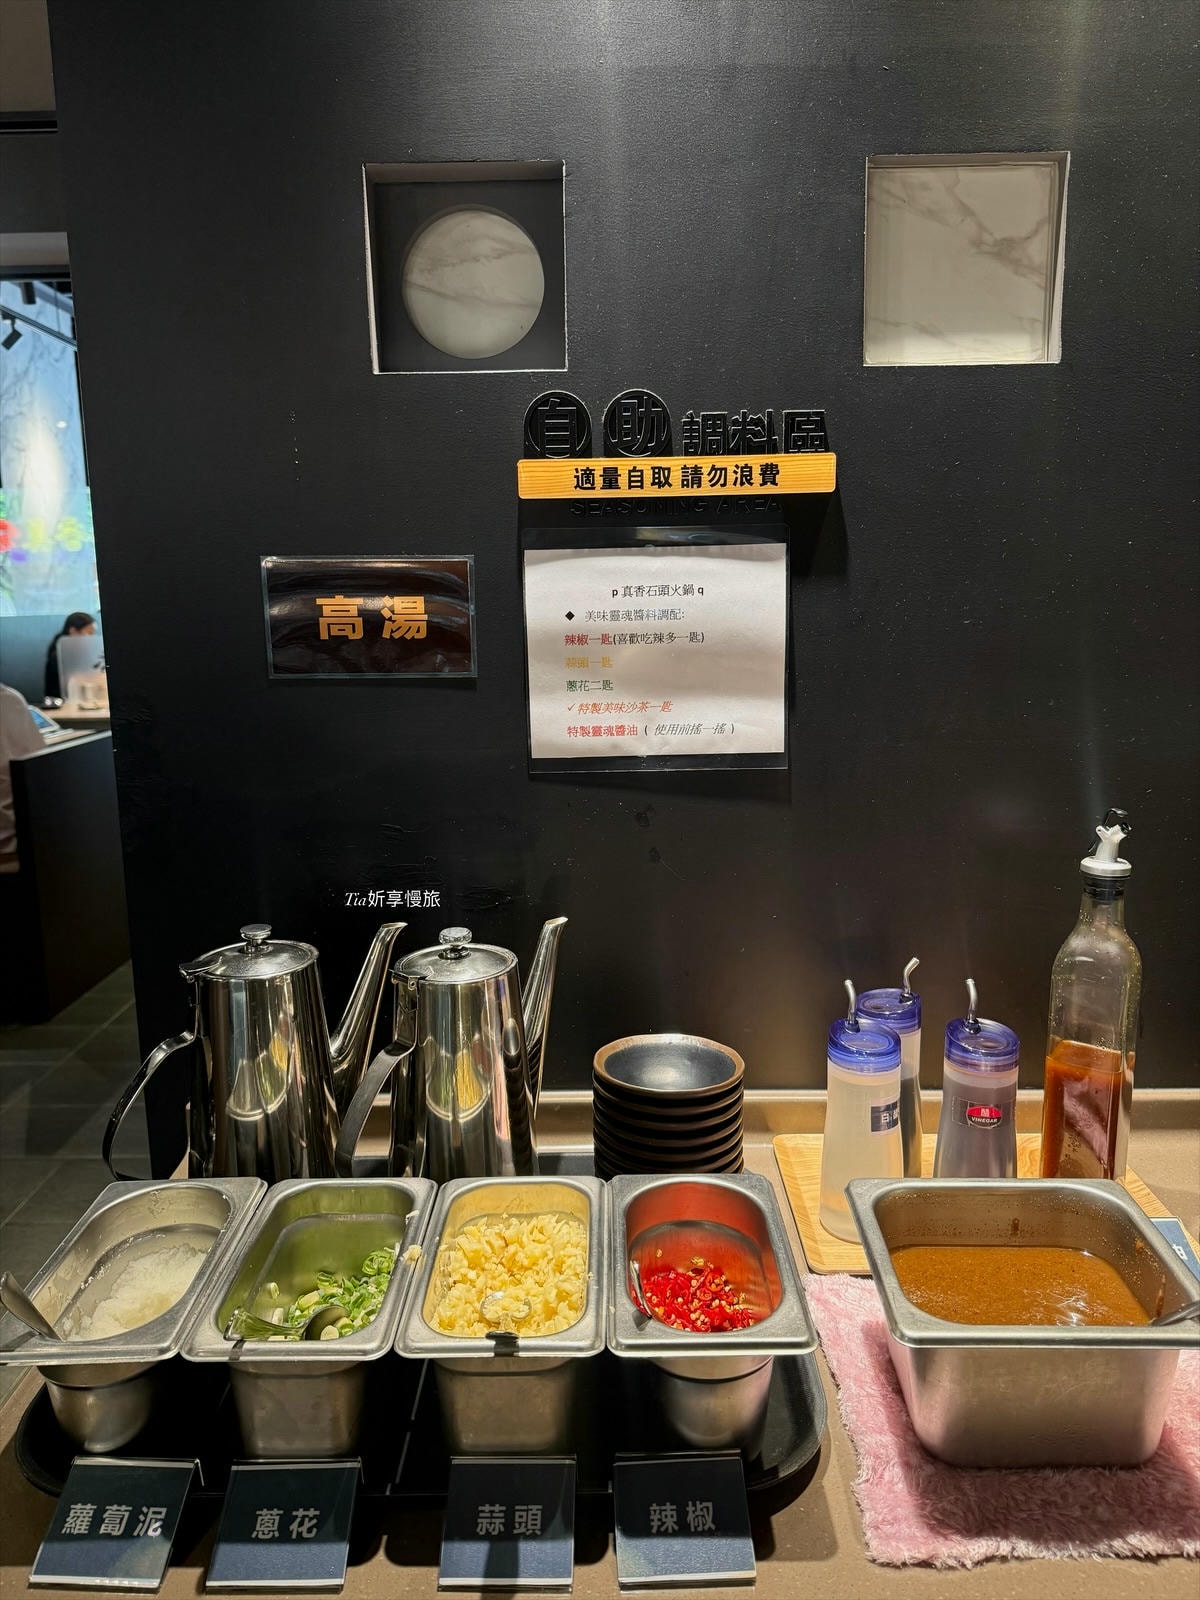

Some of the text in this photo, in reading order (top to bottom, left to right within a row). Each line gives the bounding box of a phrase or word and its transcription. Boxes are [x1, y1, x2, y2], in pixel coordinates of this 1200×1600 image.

[315, 595, 428, 640] 高湯
[61, 1503, 168, 1537] 蘿蔔泥
[252, 1508, 321, 1540] 蔥花
[476, 1503, 544, 1536] 蒜頭
[649, 1501, 716, 1534] 辣椒
